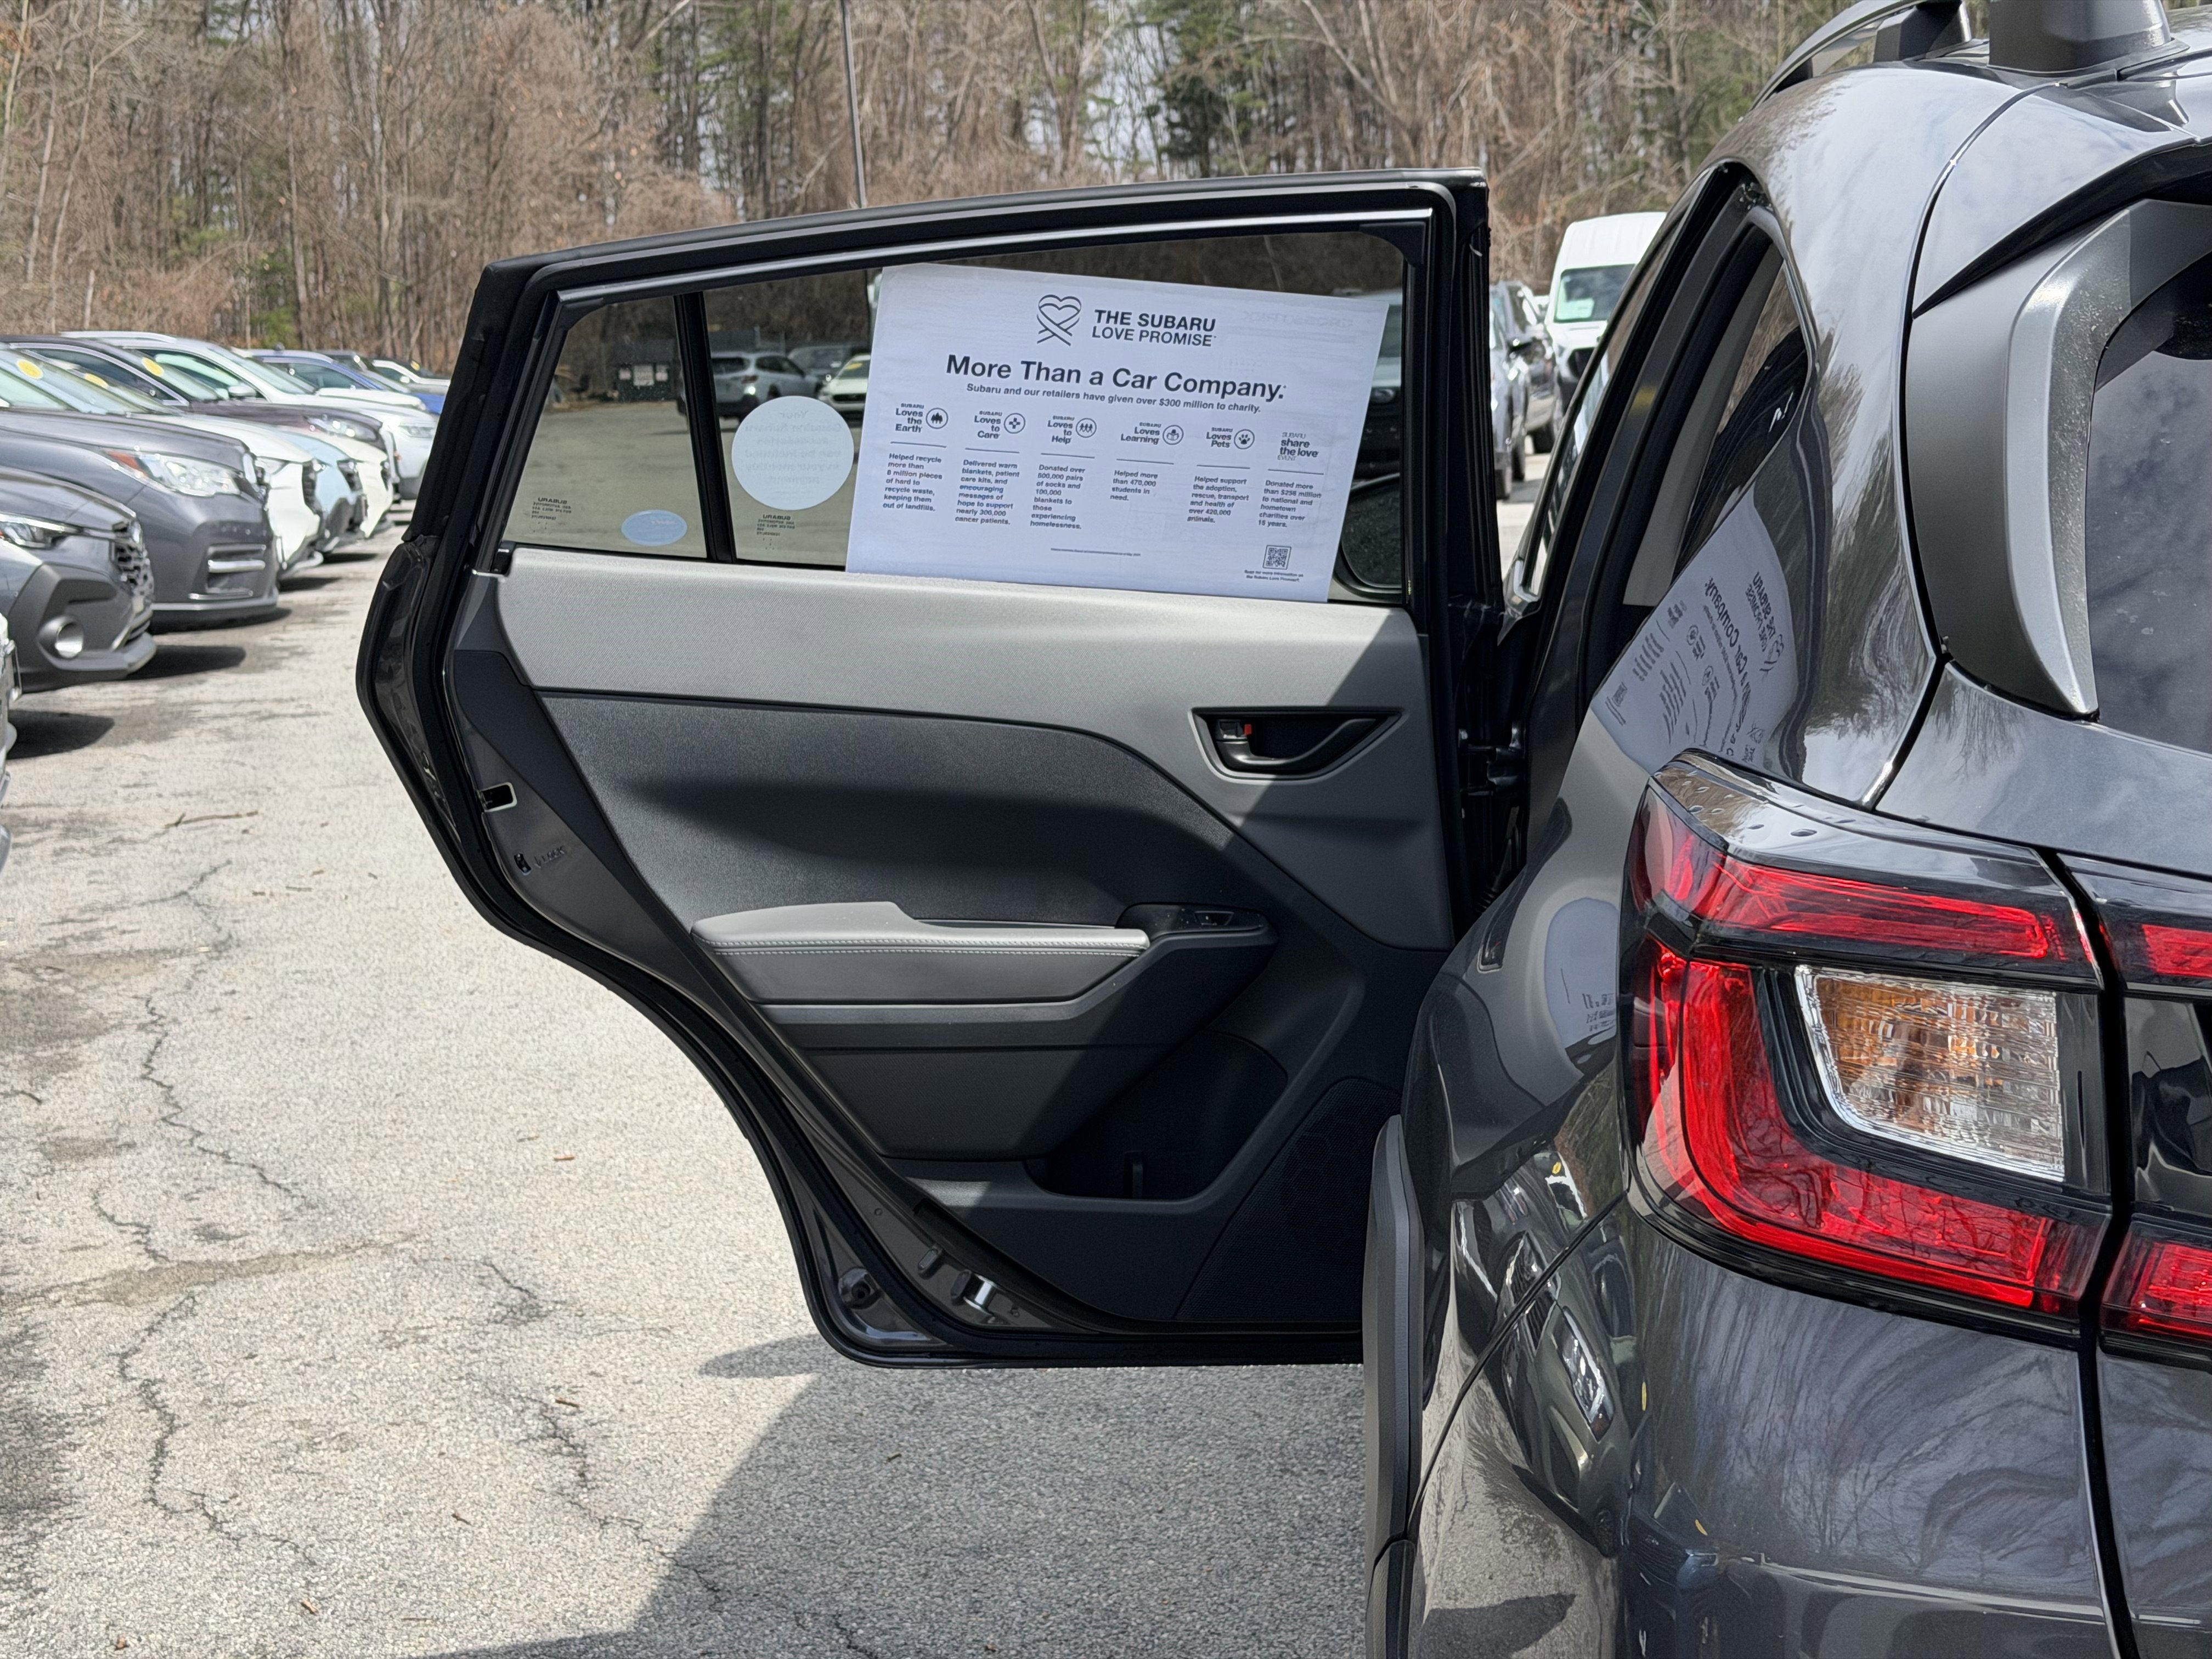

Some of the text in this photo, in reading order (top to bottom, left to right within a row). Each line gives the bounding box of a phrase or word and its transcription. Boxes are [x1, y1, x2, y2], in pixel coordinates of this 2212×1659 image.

[1094, 309, 1215, 331] THE SUBARU
[1092, 326, 1212, 346] LOVE PROMISE
[946, 354, 1286, 402] More Than a Car Company.
[966, 383, 1001, 393] Subaru
[1042, 390, 1080, 398] retailers
[1083, 392, 1105, 401] have
[1108, 394, 1133, 404] given
[1159, 398, 1181, 407] $300
[1183, 400, 1214, 409] million
[1216, 402, 1226, 410] to
[1228, 403, 1260, 414] charity.
[895, 408, 923, 417] Loves
[974, 415, 1001, 424] Loves
[1047, 420, 1073, 428] Loves
[895, 423, 922, 432] Earth
[1134, 426, 1160, 436] Loves
[977, 430, 1000, 439] Care
[1120, 433, 1159, 445] Learning
[1206, 431, 1232, 440] Loves
[1051, 435, 1071, 444] Help
[1211, 439, 1231, 448] Pets
[1280, 438, 1310, 448] share
[889, 453, 914, 461] Helped
[1279, 447, 1318, 458] the love
[963, 459, 997, 467] Delivered
[962, 467, 993, 477] blankets,
[1265, 479, 1294, 488] Donated
[959, 484, 1003, 493] encouraging
[883, 493, 912, 502] keeping
[905, 503, 935, 511] landfills.
[1260, 504, 1296, 512] hometown
[956, 508, 978, 516] nearly
[1031, 514, 1076, 522] experiencing
[1030, 520, 1081, 529] homelessness.
